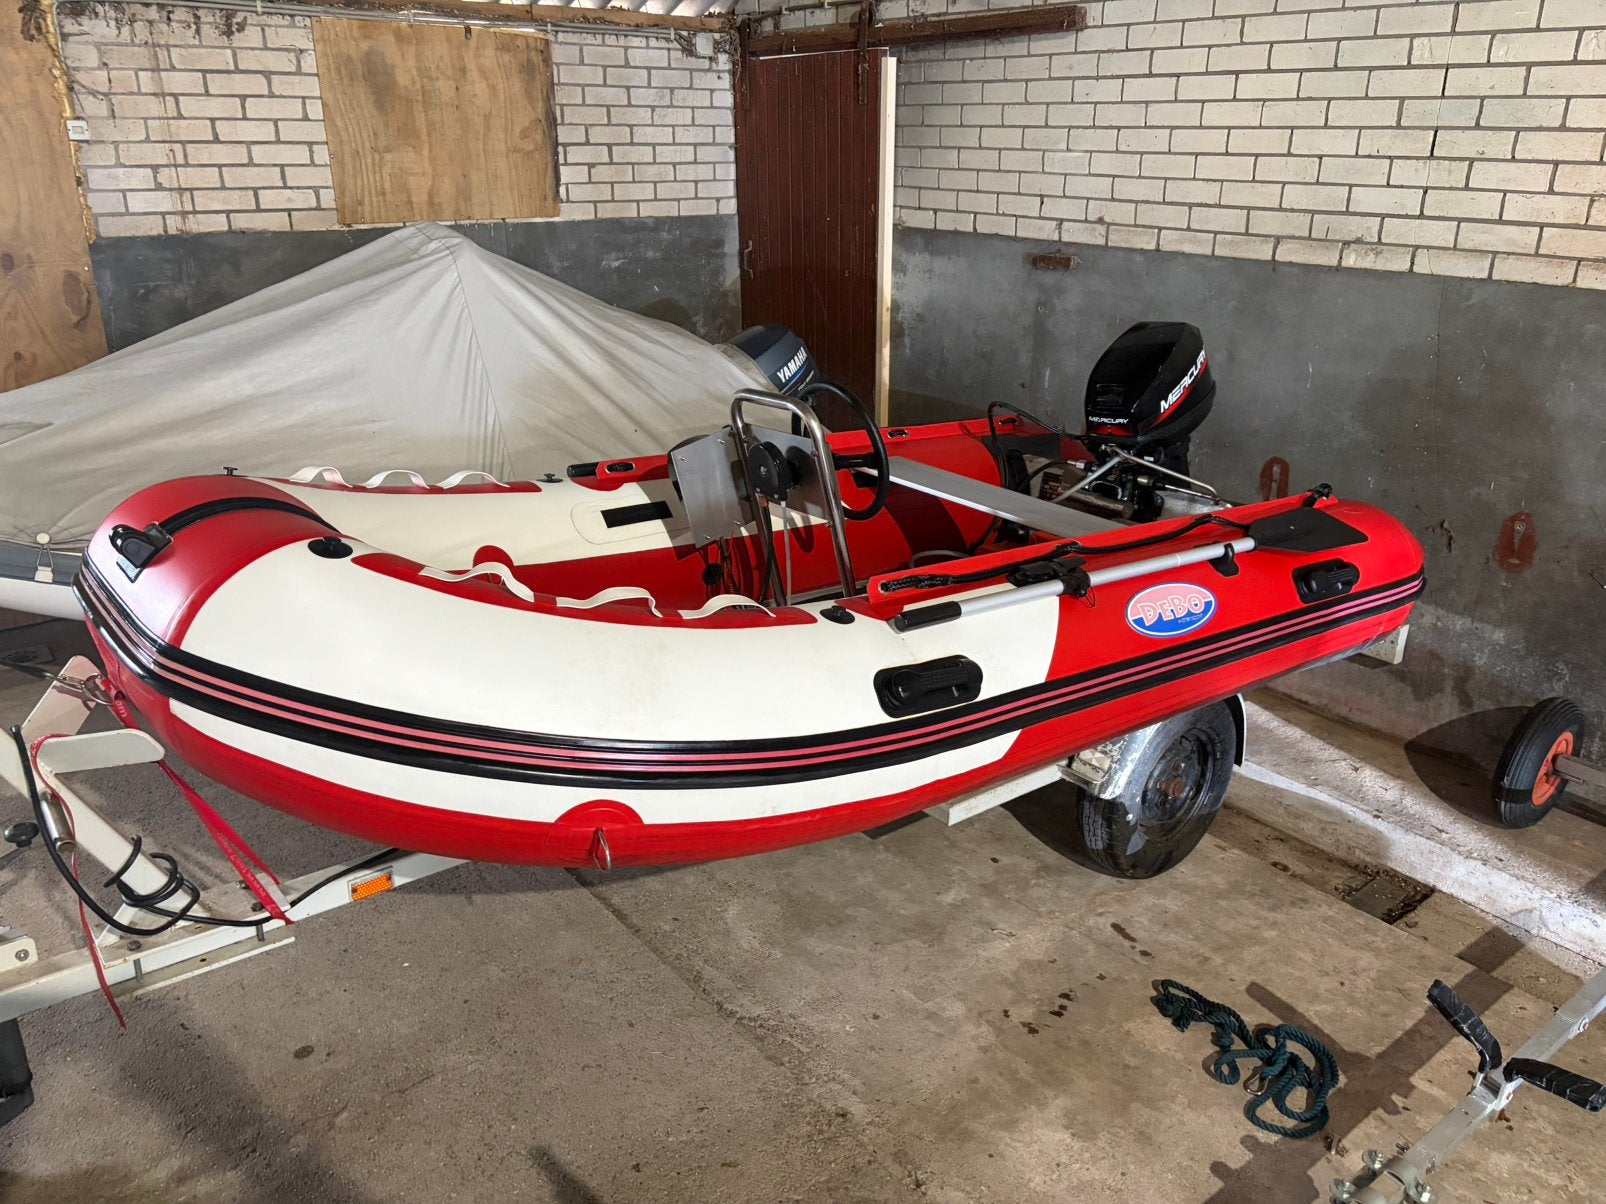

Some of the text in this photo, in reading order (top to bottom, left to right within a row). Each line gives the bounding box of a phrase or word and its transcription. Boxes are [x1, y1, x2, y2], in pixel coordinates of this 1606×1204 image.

[777, 346, 808, 383] YAMAHA
[1160, 345, 1206, 413] MERCUR
[1088, 416, 1129, 424] MERCURY
[1138, 594, 1205, 626] DEBO
